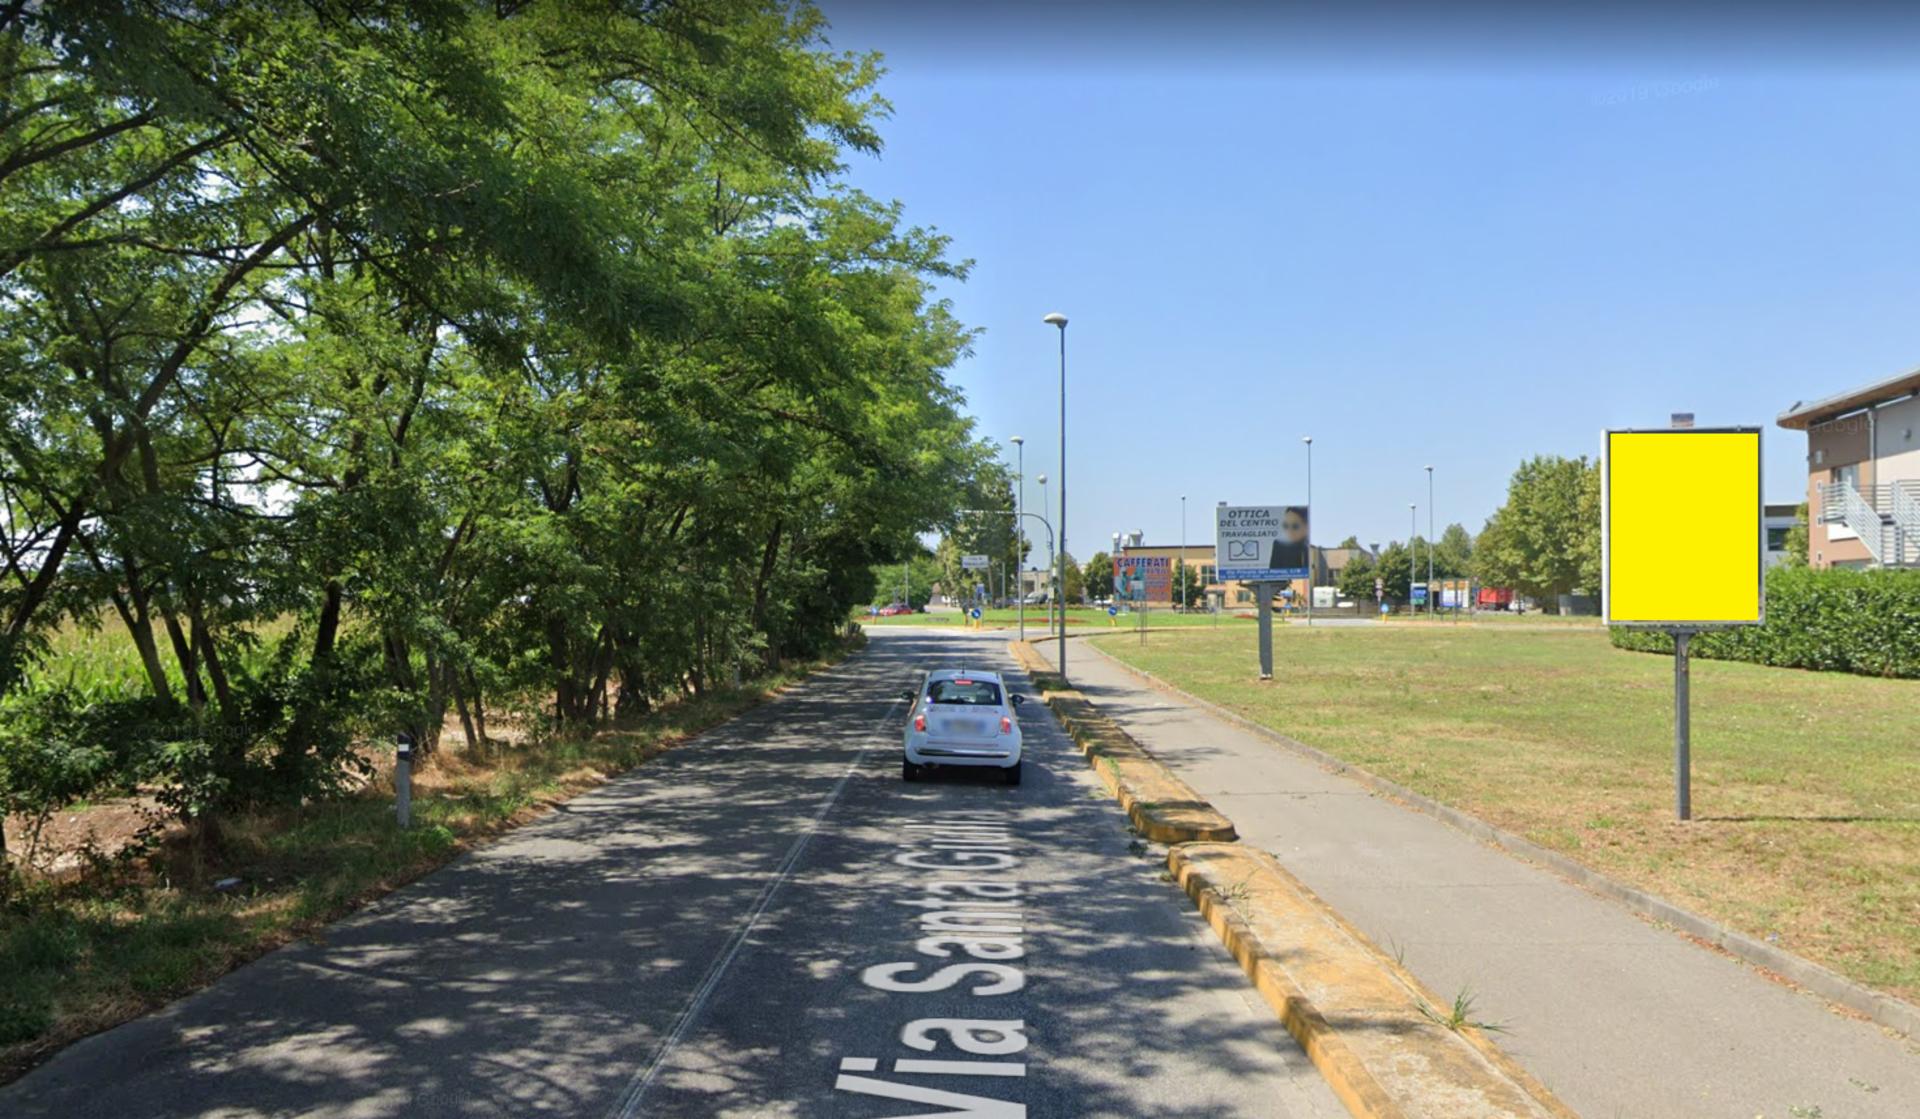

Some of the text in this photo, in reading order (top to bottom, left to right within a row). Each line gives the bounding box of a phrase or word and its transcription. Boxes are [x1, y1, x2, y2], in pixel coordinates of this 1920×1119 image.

[1228, 509, 1270, 519] OTTICA
[1220, 518, 1279, 528] DEL CENTRO
[1221, 529, 1279, 538] TRAVAGLIATO
[861, 881, 1026, 996] Santa
[834, 1017, 1028, 1119] Via
